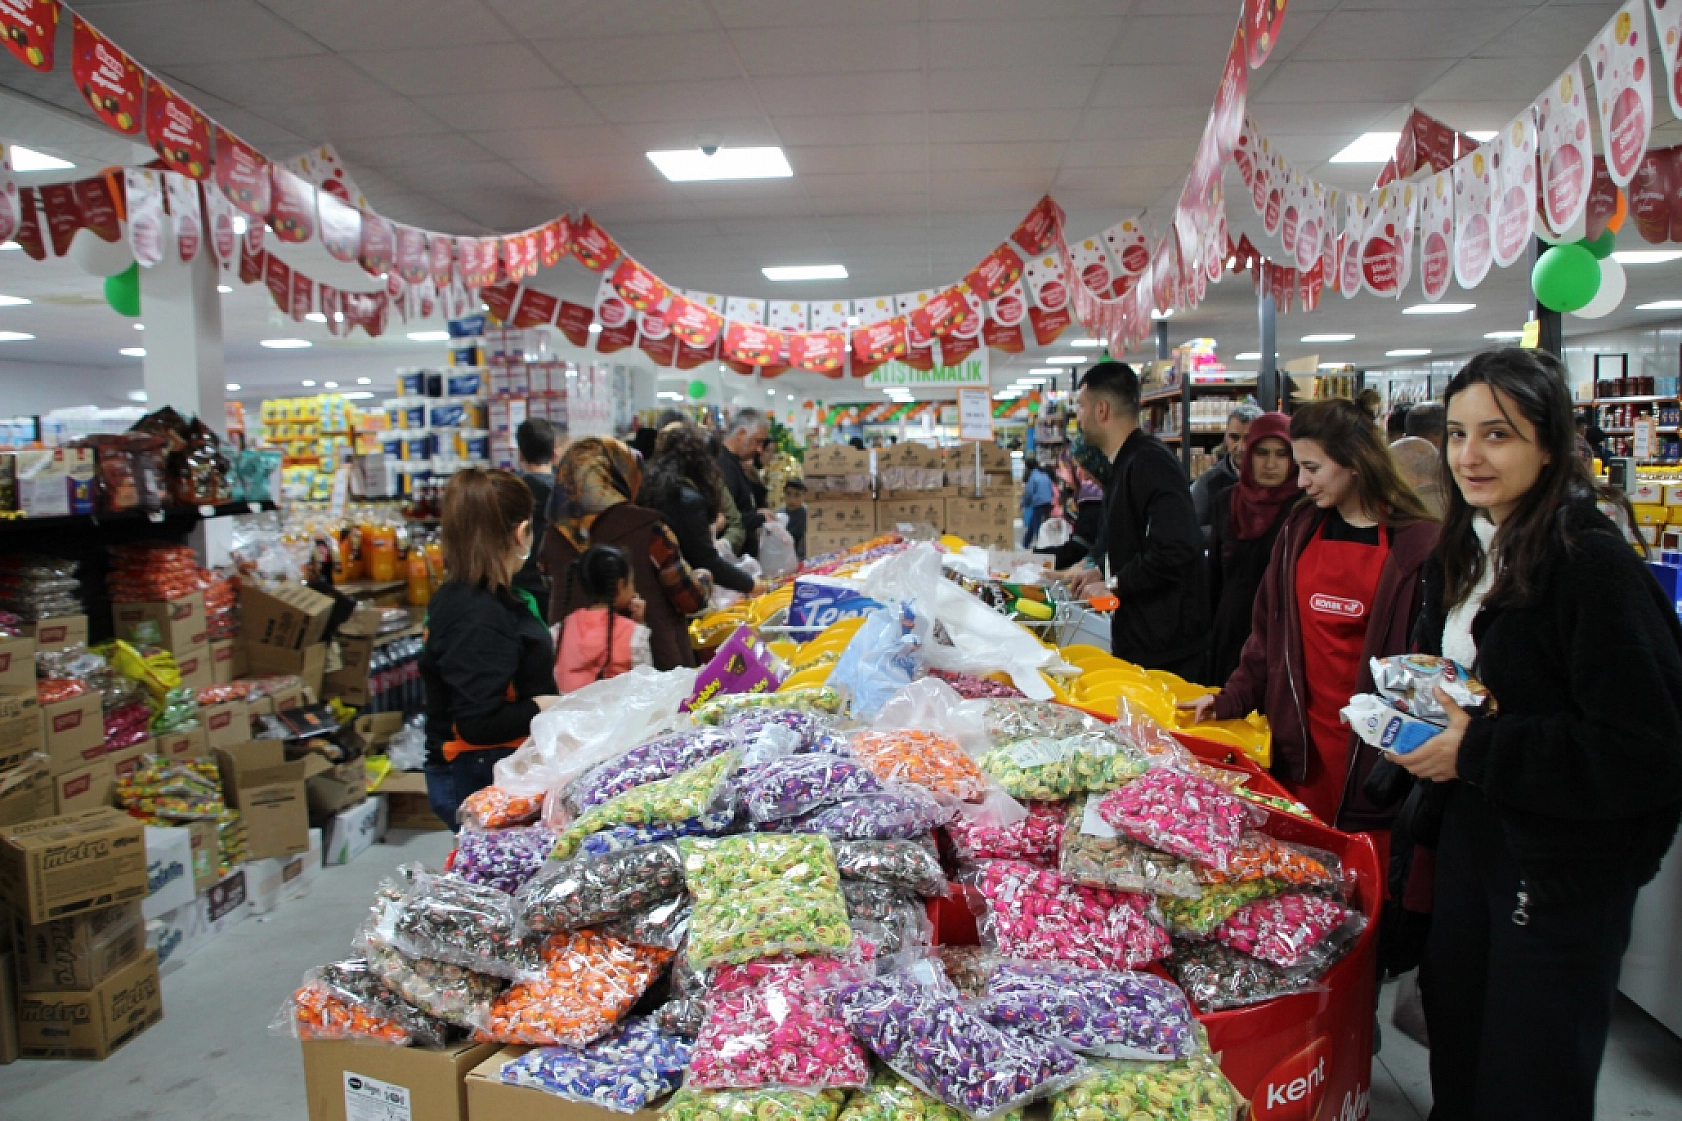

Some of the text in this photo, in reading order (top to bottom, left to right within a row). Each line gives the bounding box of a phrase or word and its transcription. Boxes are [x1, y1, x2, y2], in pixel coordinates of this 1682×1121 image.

[44, 837, 109, 869] metro
[21, 1001, 90, 1023] metro
[112, 975, 155, 1022] metro
[1266, 1055, 1325, 1110] kent
